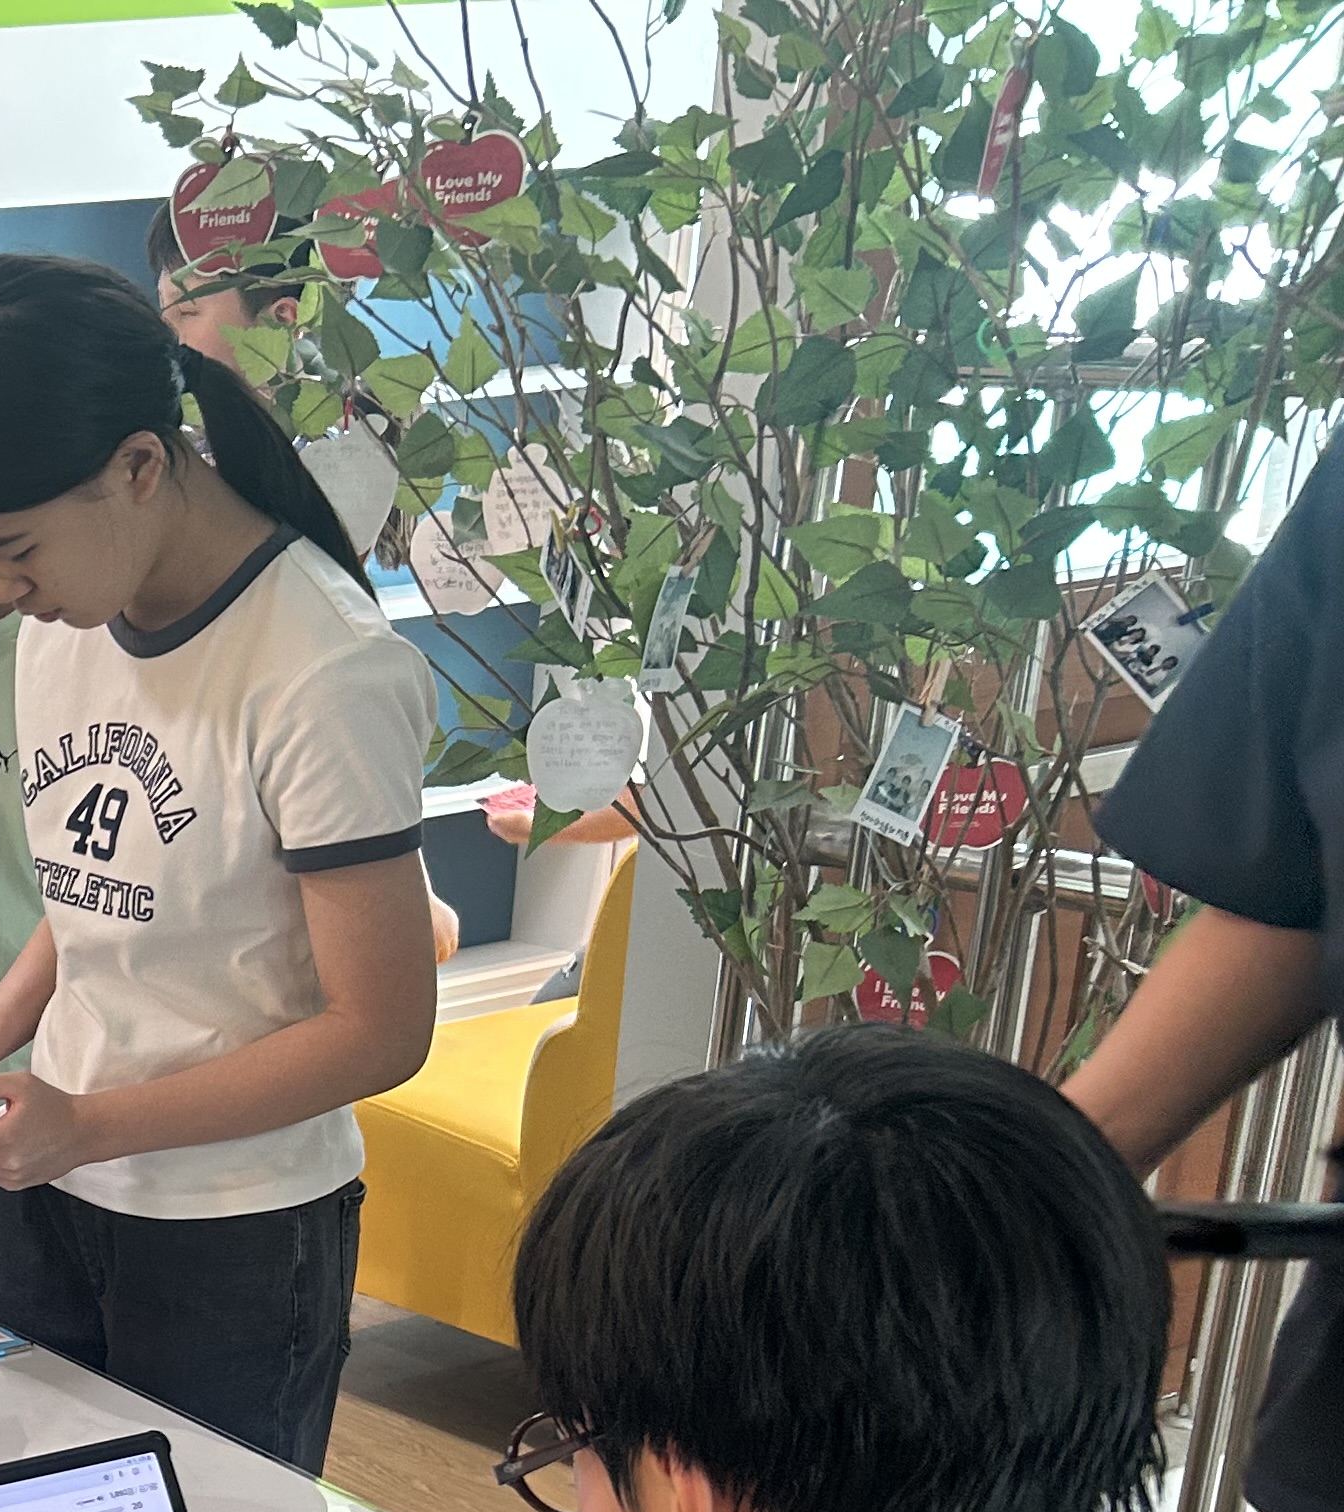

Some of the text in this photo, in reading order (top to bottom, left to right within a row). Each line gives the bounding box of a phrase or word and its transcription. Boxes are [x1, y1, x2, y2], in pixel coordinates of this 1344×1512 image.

[434, 187, 492, 206] Friends
[435, 174, 474, 190] Love
[477, 170, 503, 188] My
[199, 210, 251, 229] Friends
[20, 722, 198, 845] CALIFORNIA
[65, 782, 129, 862] 49
[34, 857, 154, 922] THLETIC
